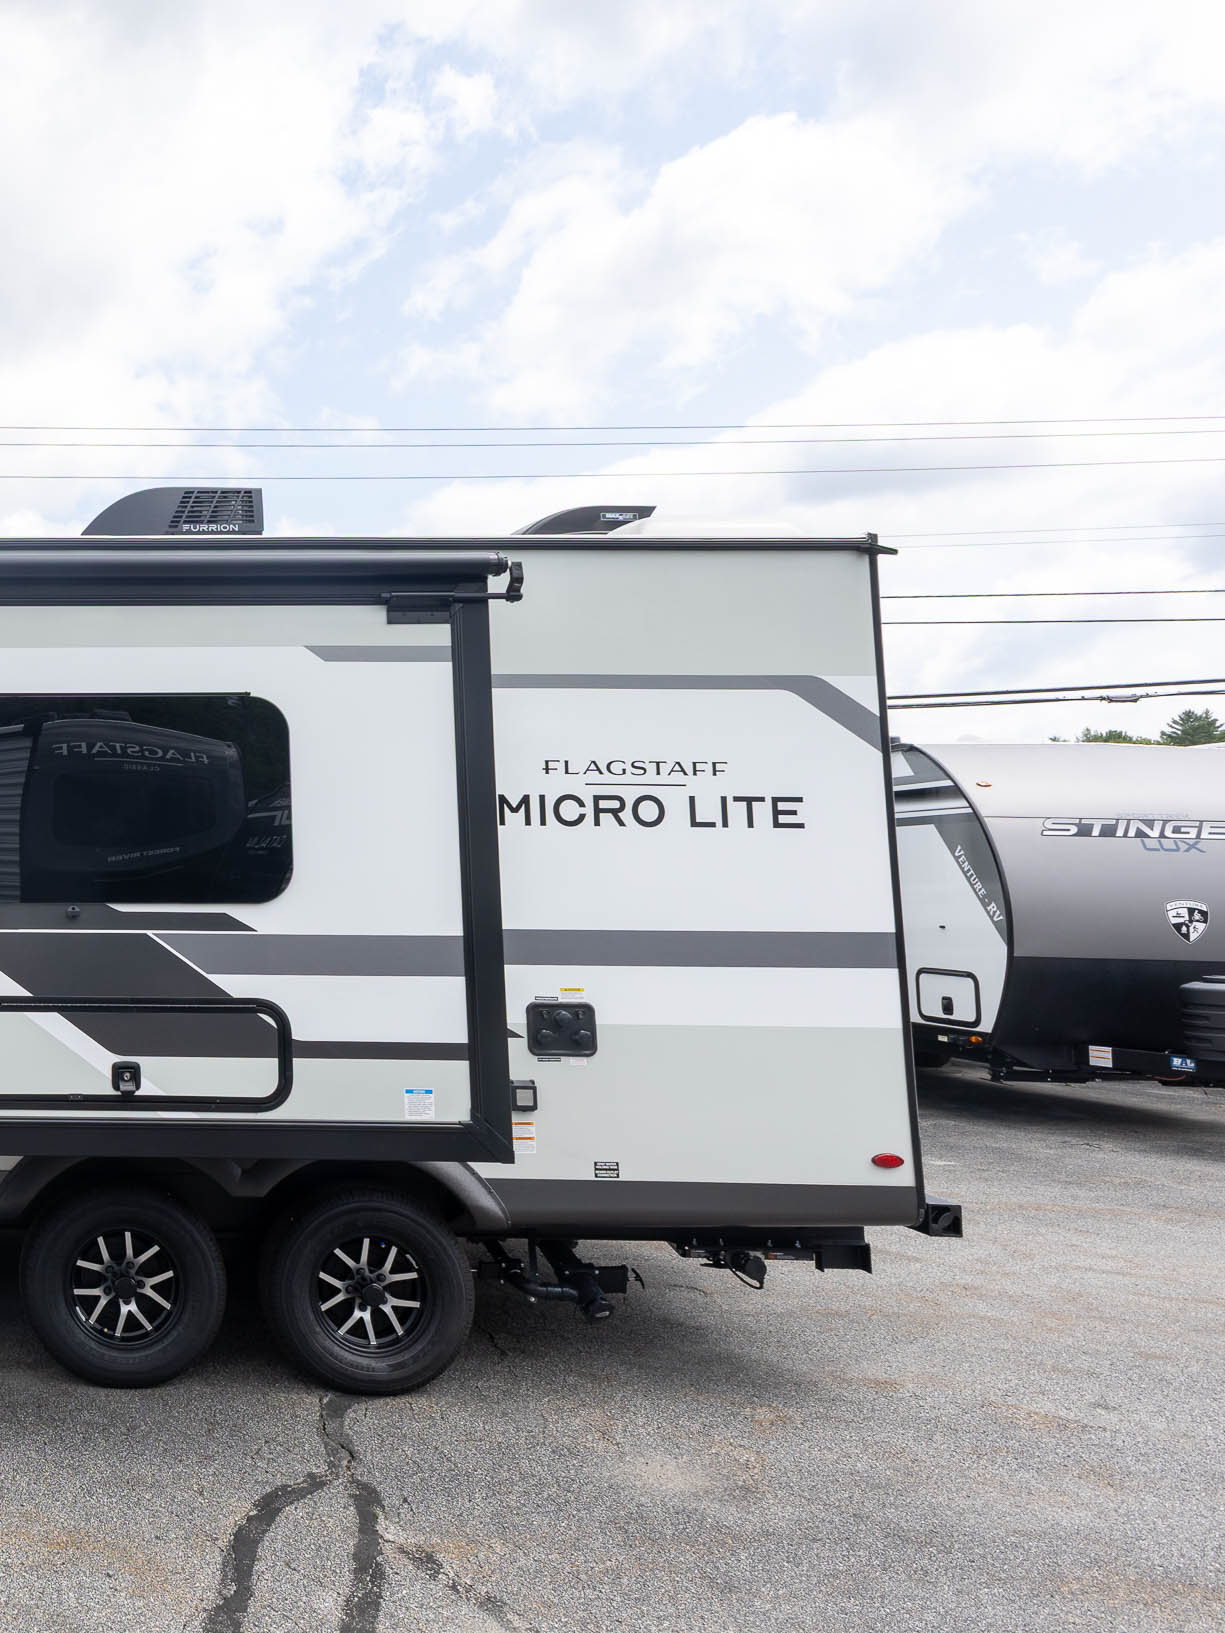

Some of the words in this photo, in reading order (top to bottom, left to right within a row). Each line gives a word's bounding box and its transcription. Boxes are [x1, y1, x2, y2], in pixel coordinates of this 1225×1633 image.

[181, 524, 239, 532] FURRION
[542, 759, 728, 777] FLAGSTAFF
[497, 794, 665, 828] MICRO
[688, 795, 806, 829] LITE
[1140, 838, 1207, 853] LUX
[986, 901, 1004, 922] RV
